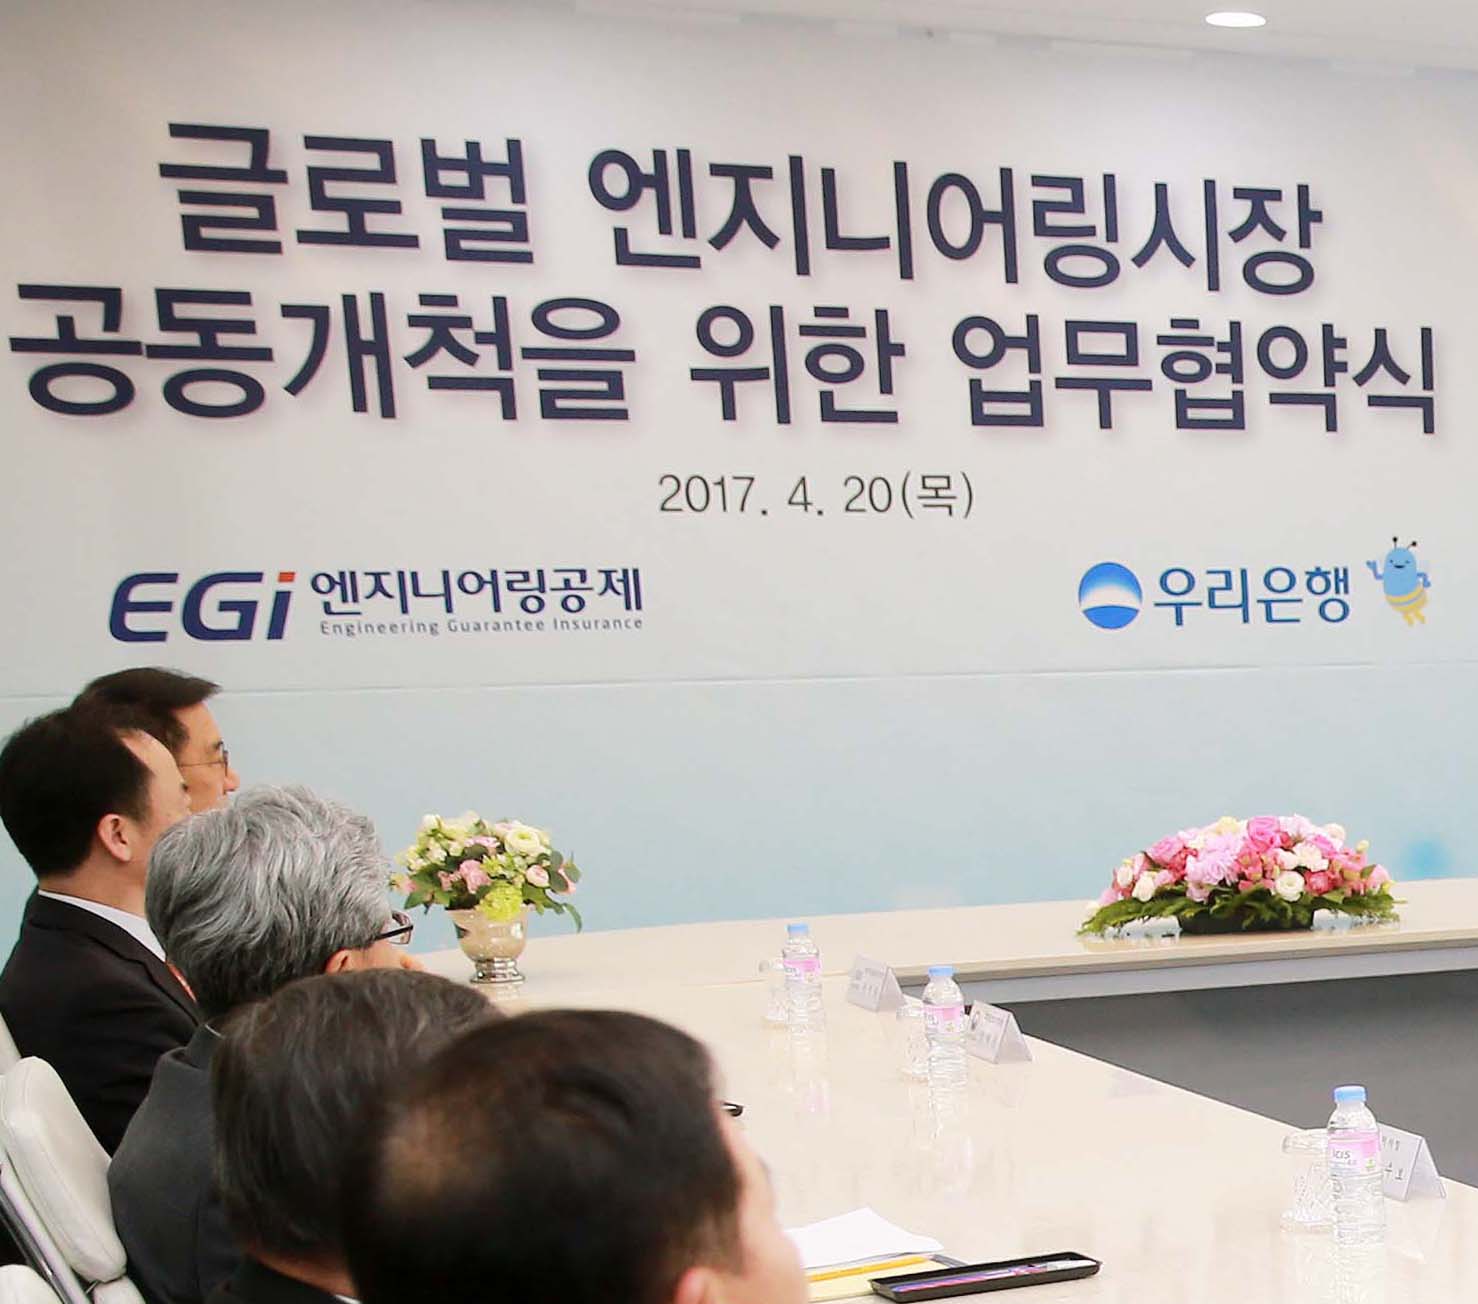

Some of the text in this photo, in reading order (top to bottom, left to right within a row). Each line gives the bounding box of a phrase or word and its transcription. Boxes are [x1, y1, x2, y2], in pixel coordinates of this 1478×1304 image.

[158, 121, 1323, 296] 글로벌 엔지니어링시장
[8, 282, 1437, 435] 공동개척을 위한 업무협약식
[657, 471, 974, 519] 2017. 4. 20(목)
[310, 567, 644, 616] 엔지니어링공제
[1152, 566, 1352, 627] 우리은행
[320, 616, 644, 637] Engineering Guarantee Insurance
